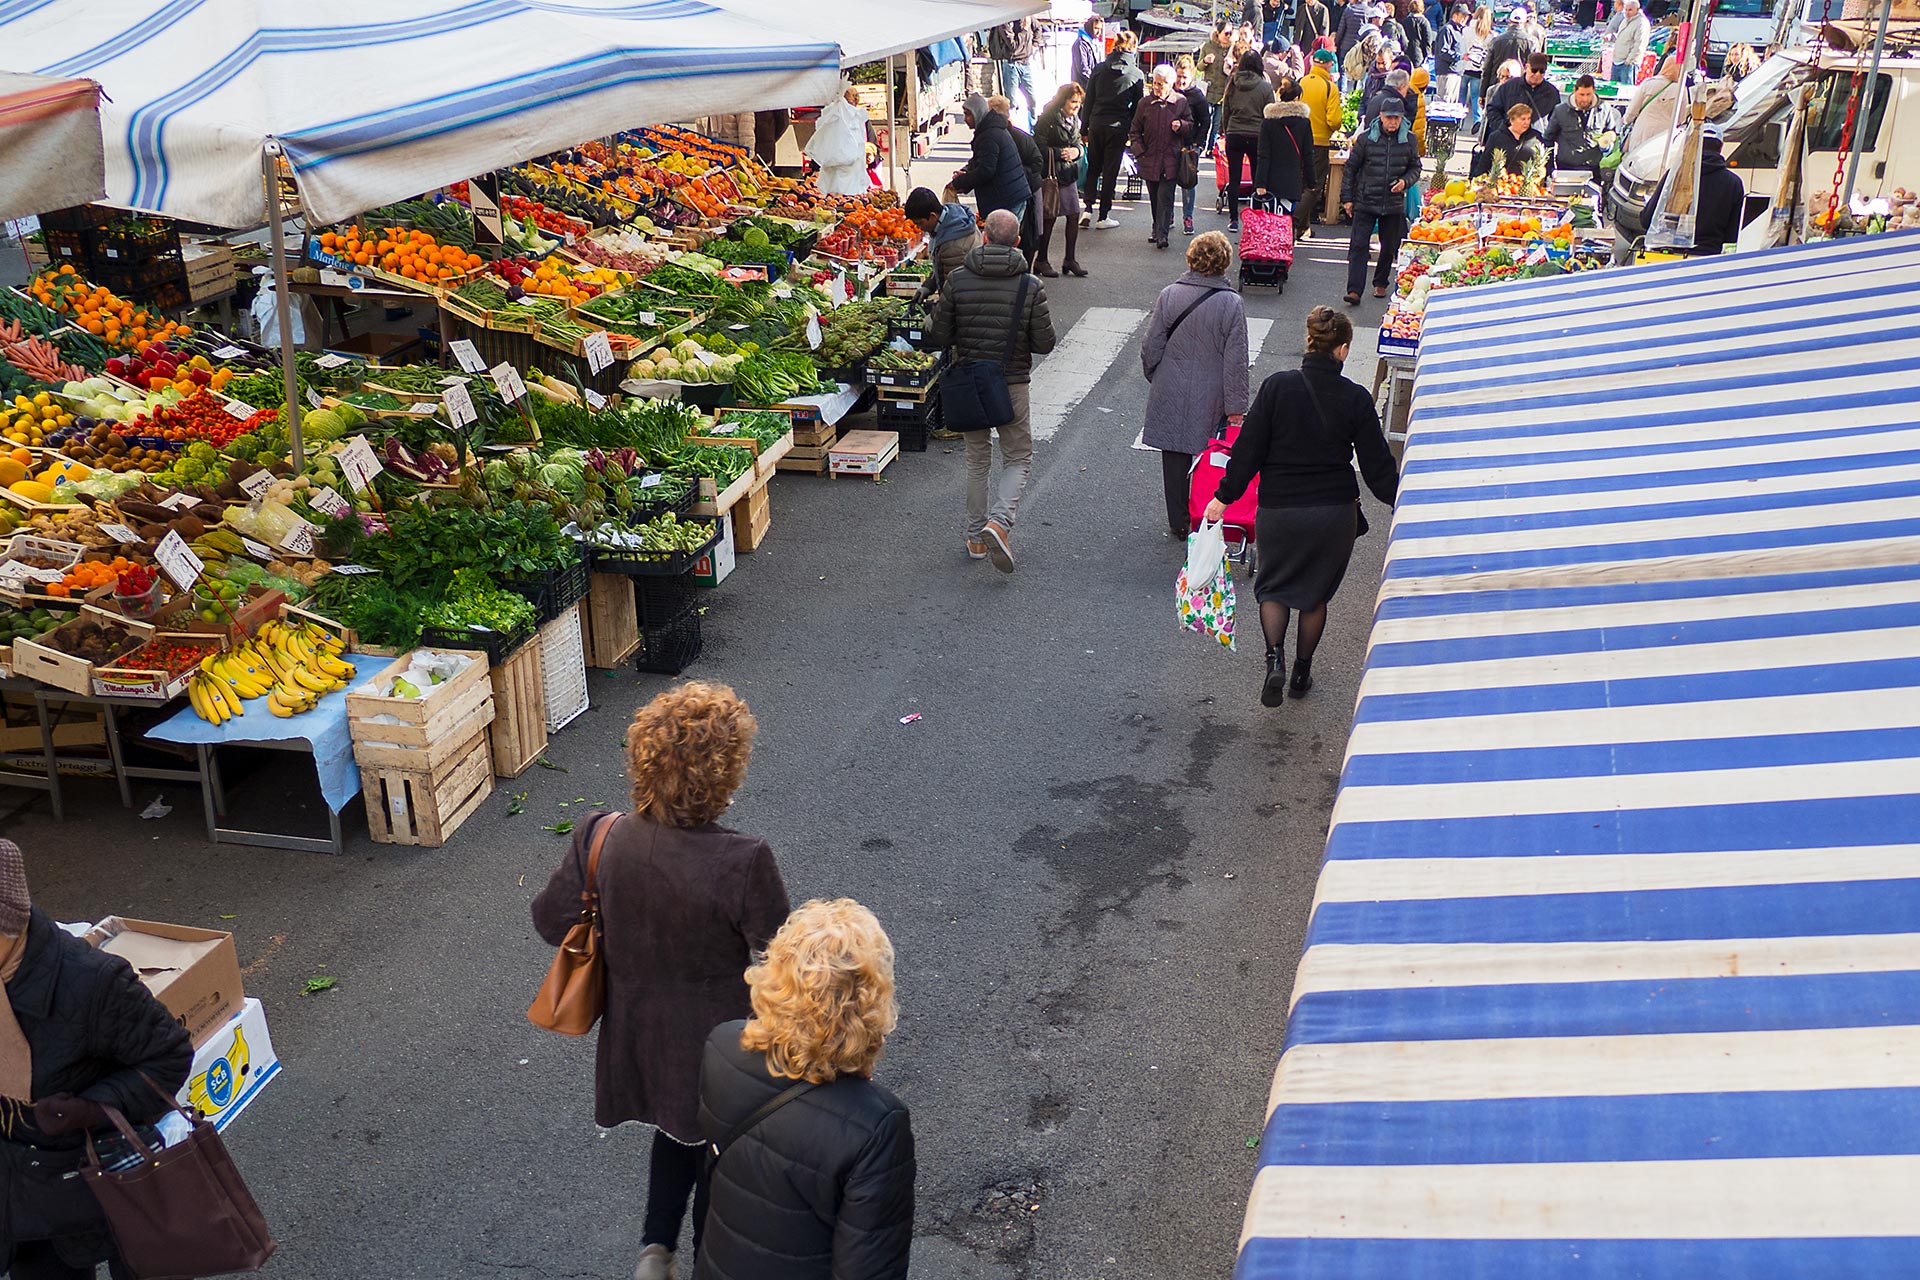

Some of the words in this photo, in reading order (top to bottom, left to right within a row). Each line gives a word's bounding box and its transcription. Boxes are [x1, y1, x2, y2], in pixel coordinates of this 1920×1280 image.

[313, 250, 350, 270] Marlene
[16, 759, 48, 768] Extra
[210, 1069, 227, 1090] SCB
